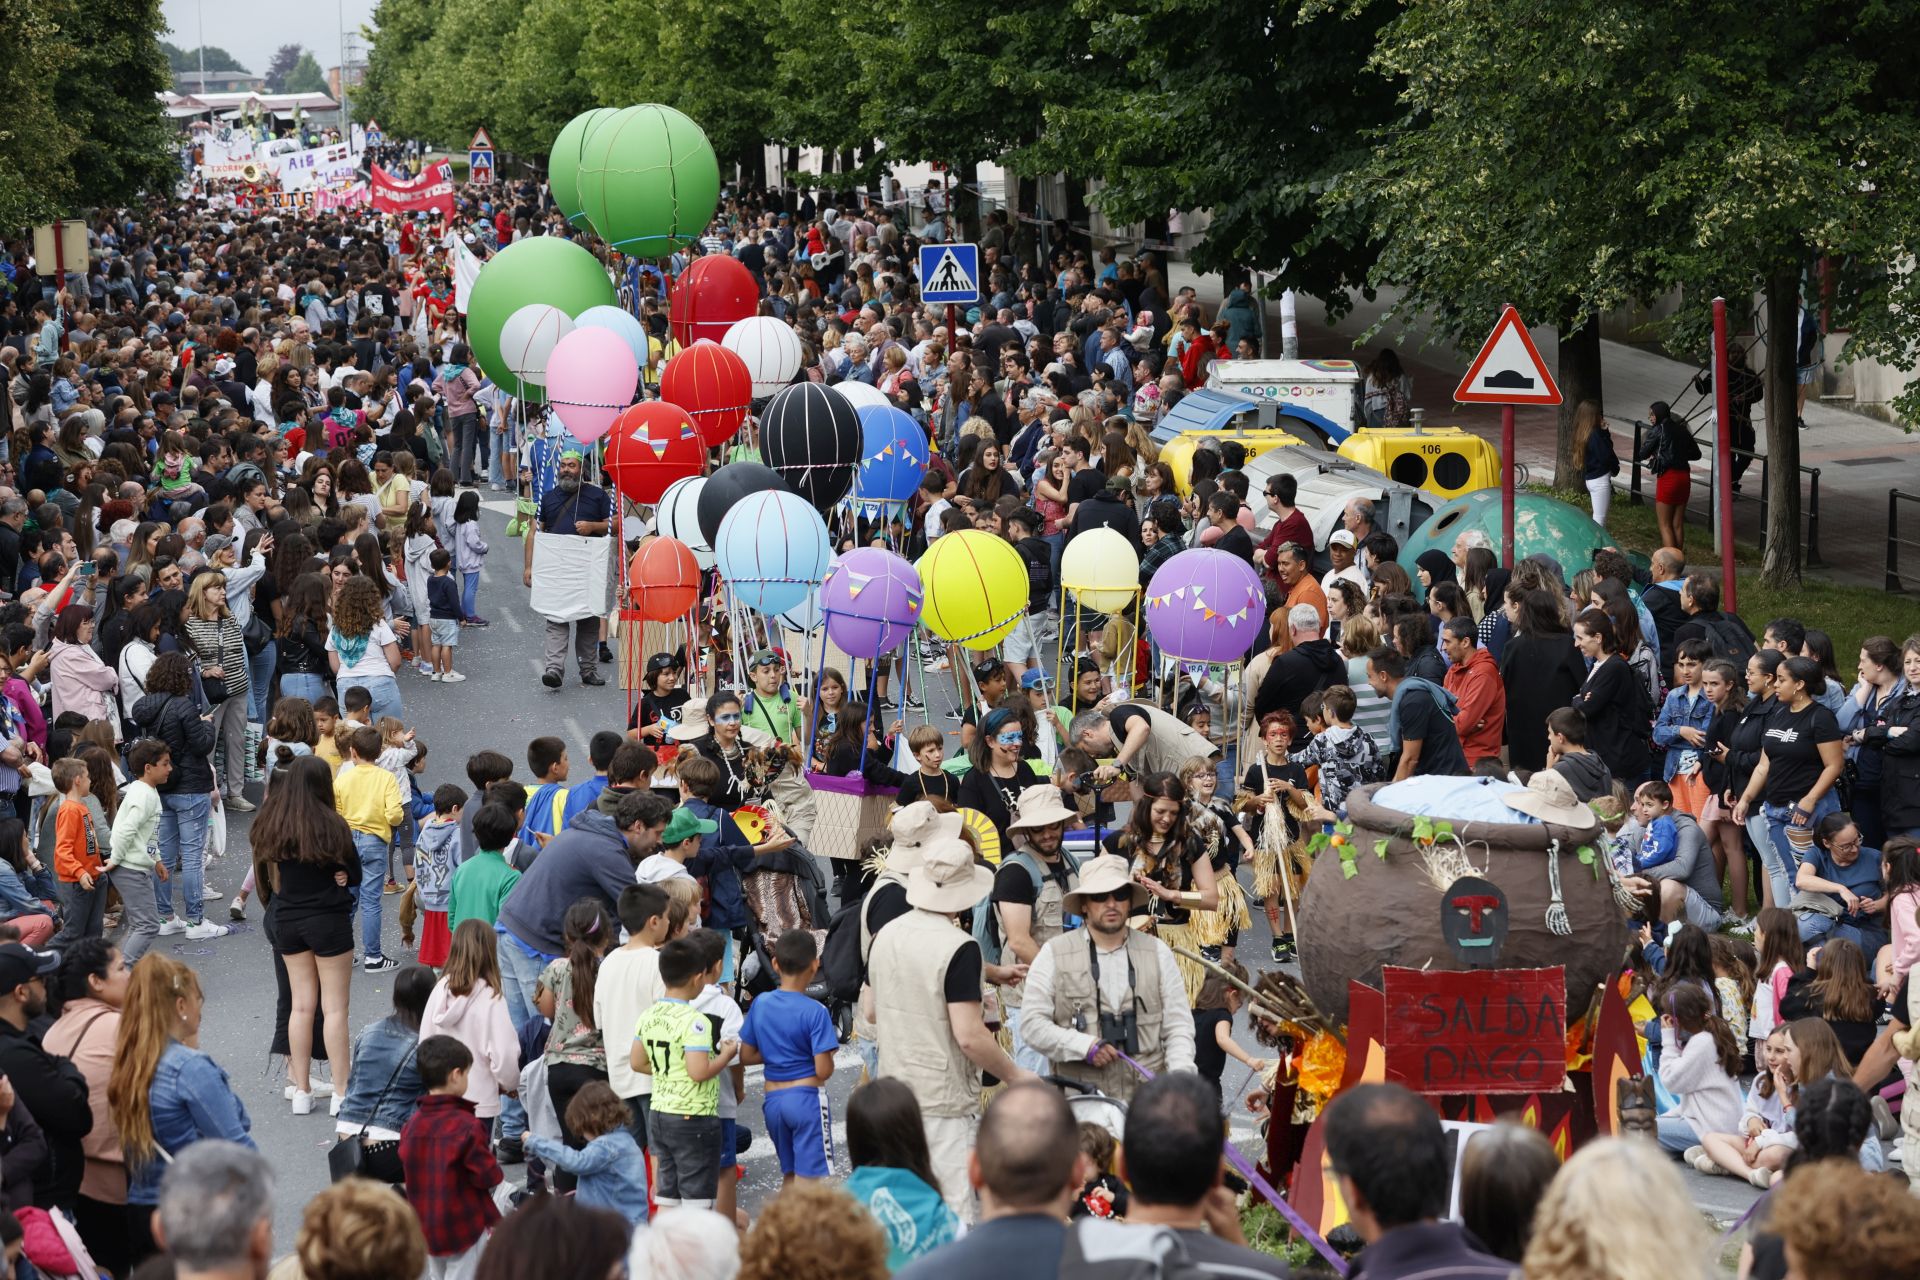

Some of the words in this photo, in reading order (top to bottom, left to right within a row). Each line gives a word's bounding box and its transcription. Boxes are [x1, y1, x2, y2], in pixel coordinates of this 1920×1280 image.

[1421, 444, 1441, 455] 106
[1188, 664, 1203, 673] IRA
[1420, 993, 1562, 1038] SALDA
[647, 1039, 670, 1078] 17
[1423, 1045, 1545, 1084] DAGO
